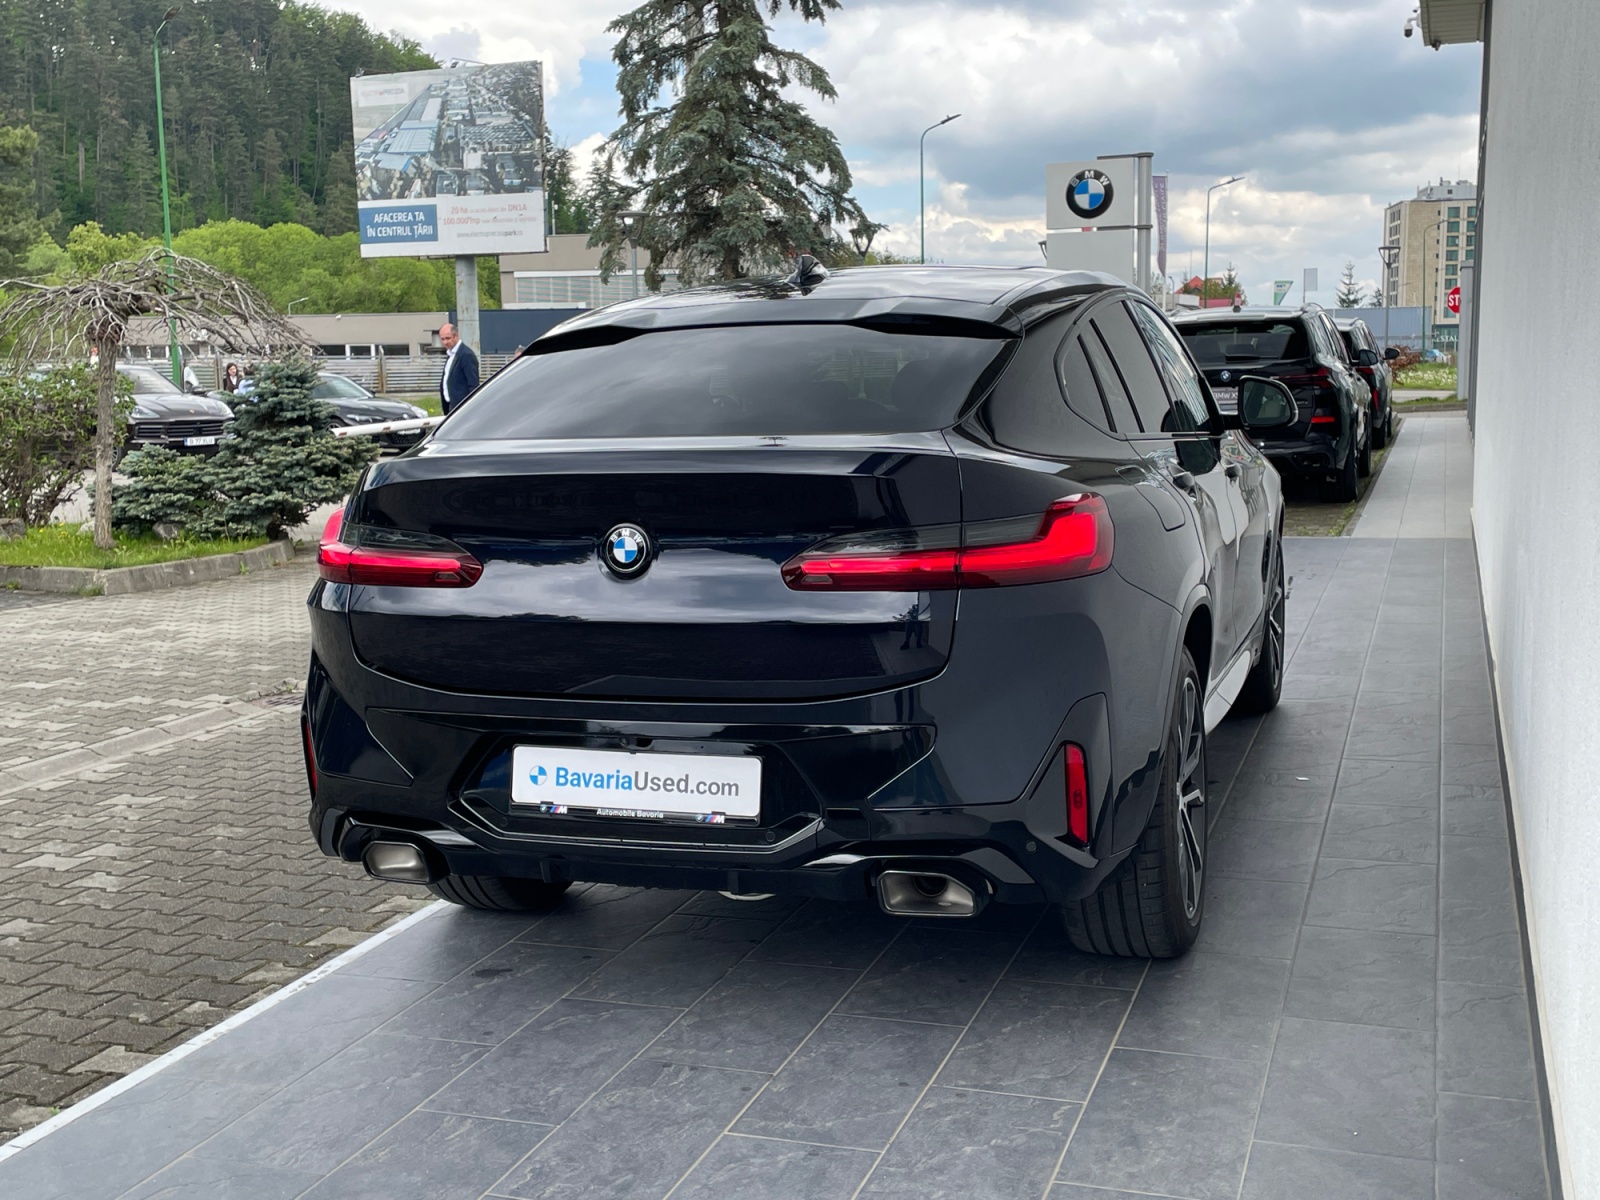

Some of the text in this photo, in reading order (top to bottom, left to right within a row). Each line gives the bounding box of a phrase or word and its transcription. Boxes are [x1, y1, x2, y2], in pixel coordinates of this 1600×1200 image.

[1070, 170, 1110, 187] BMW
[373, 211, 425, 223] AFACEREA TA
[366, 225, 376, 238] ÎN
[377, 225, 412, 237] CENTRUL
[610, 528, 644, 543] BMW
[555, 766, 740, 797] BavariaUsed.com
[596, 808, 664, 819] Automobile Bavaria
